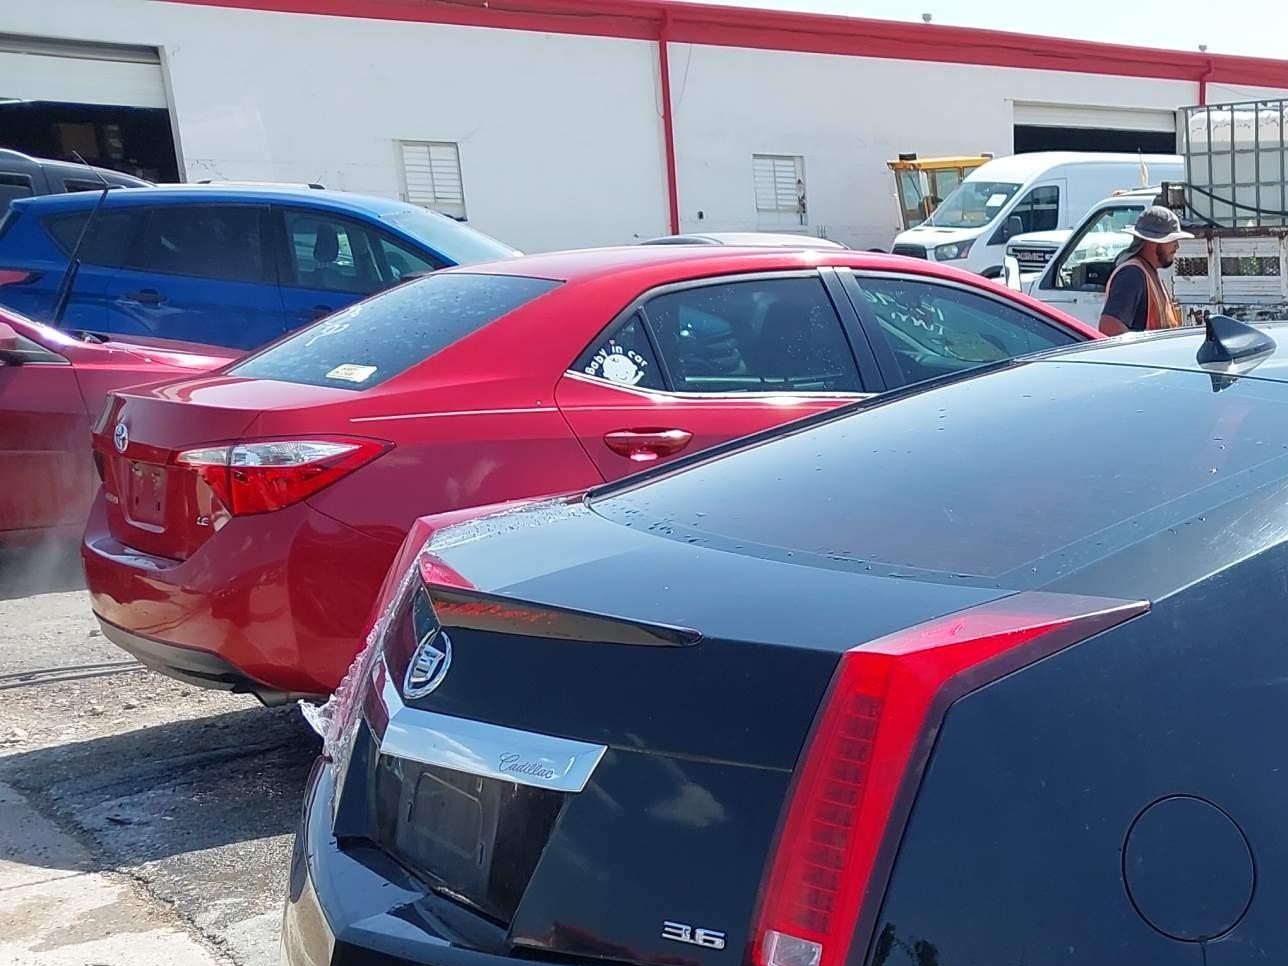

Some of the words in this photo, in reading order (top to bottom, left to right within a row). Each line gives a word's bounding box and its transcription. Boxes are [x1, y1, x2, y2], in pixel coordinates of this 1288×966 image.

[1020, 251, 1044, 261] GMC
[584, 347, 608, 375] Baby
[609, 341, 623, 354] in
[499, 752, 554, 779] Cadillac
